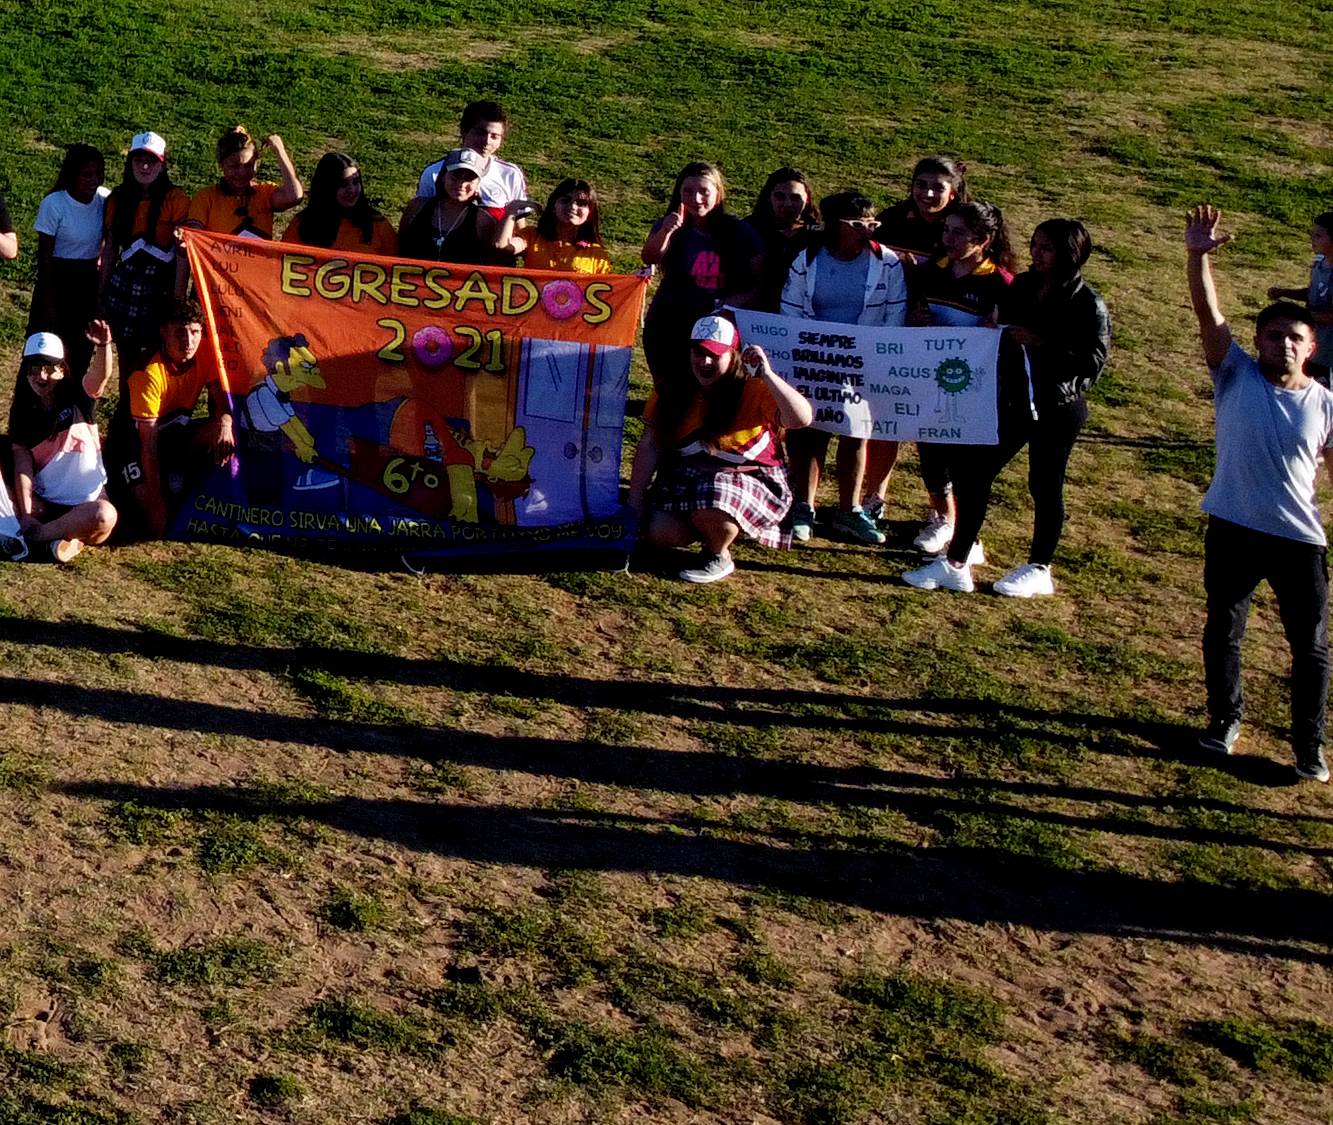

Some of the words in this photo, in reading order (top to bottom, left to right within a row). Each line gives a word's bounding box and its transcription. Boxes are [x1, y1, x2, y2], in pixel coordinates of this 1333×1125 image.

[280, 252, 614, 325] EGRESADOS
[376, 317, 506, 372] 2021
[751, 324, 788, 337] HUGO
[875, 341, 904, 355] BRI
[923, 338, 967, 352] TUTY
[797, 330, 856, 349] SIEMPRE
[791, 348, 864, 369] BRILLAMOS
[888, 365, 931, 379] AGUS
[797, 385, 813, 399] EL
[815, 386, 862, 405] ULTIMO
[894, 402, 921, 417] ELI
[869, 383, 912, 396] MAGA
[815, 406, 844, 424] AÑO
[860, 418, 898, 435] TATI
[918, 427, 962, 440] FRAN
[121, 461, 141, 484] 15
[194, 494, 284, 527] CANTINERO
[289, 510, 340, 531] SIRVA
[345, 516, 382, 535] UNA
[388, 518, 446, 539] JARRA
[451, 525, 487, 540] POR
